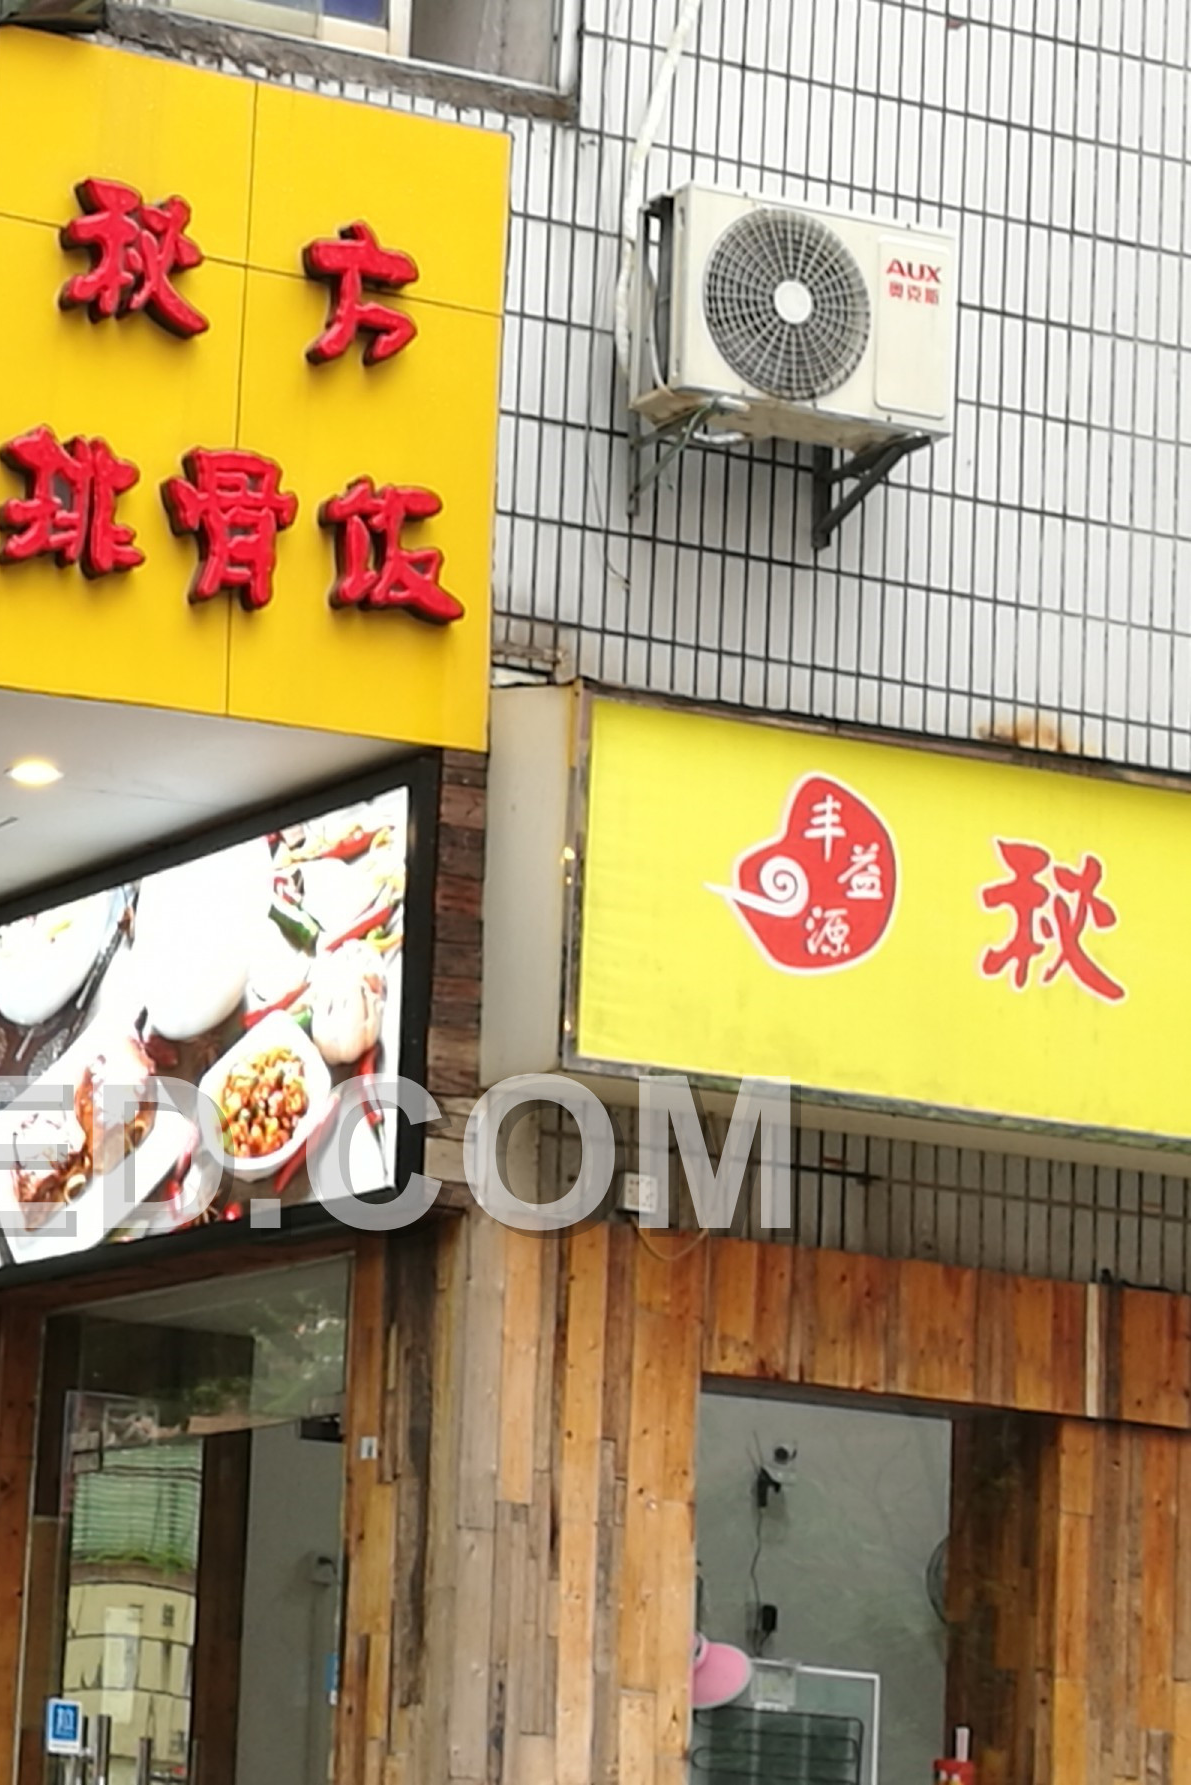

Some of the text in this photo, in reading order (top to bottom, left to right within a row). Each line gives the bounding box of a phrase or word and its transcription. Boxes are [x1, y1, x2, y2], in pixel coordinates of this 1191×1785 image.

[58, 176, 419, 366] 秘方
[886, 258, 941, 283] AUX
[803, 793, 885, 958] 丰益源
[982, 838, 1126, 1002] 秘
